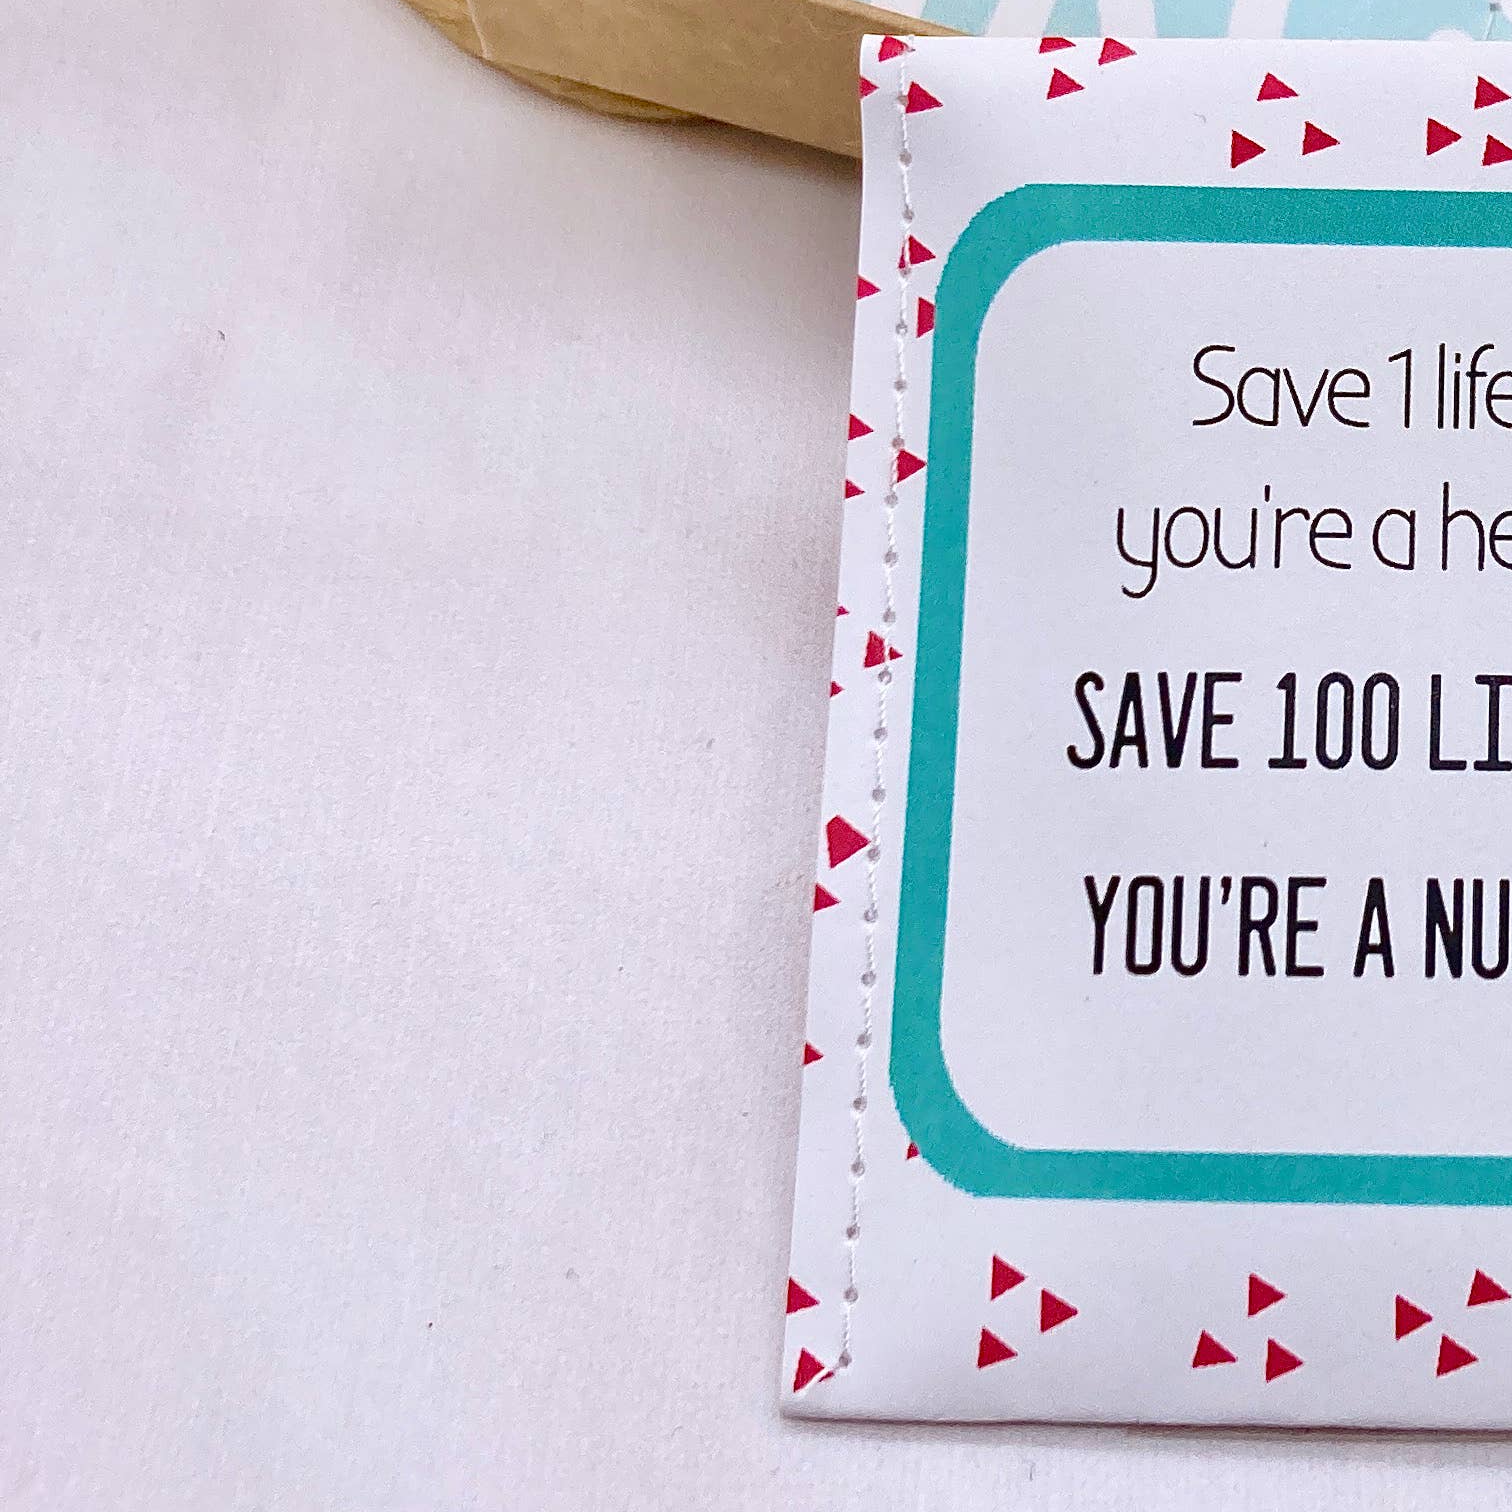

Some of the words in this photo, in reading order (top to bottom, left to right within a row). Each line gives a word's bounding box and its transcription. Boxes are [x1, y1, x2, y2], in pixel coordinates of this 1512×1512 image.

[1192, 344, 1371, 428] Save
[1388, 348, 1413, 429] 1
[1116, 484, 1353, 599] you're
[1372, 508, 1416, 571] a
[1066, 670, 1243, 770] SAVE
[1267, 671, 1400, 771] 100
[1083, 874, 1328, 978] YOU'RE
[1353, 877, 1395, 979] A
